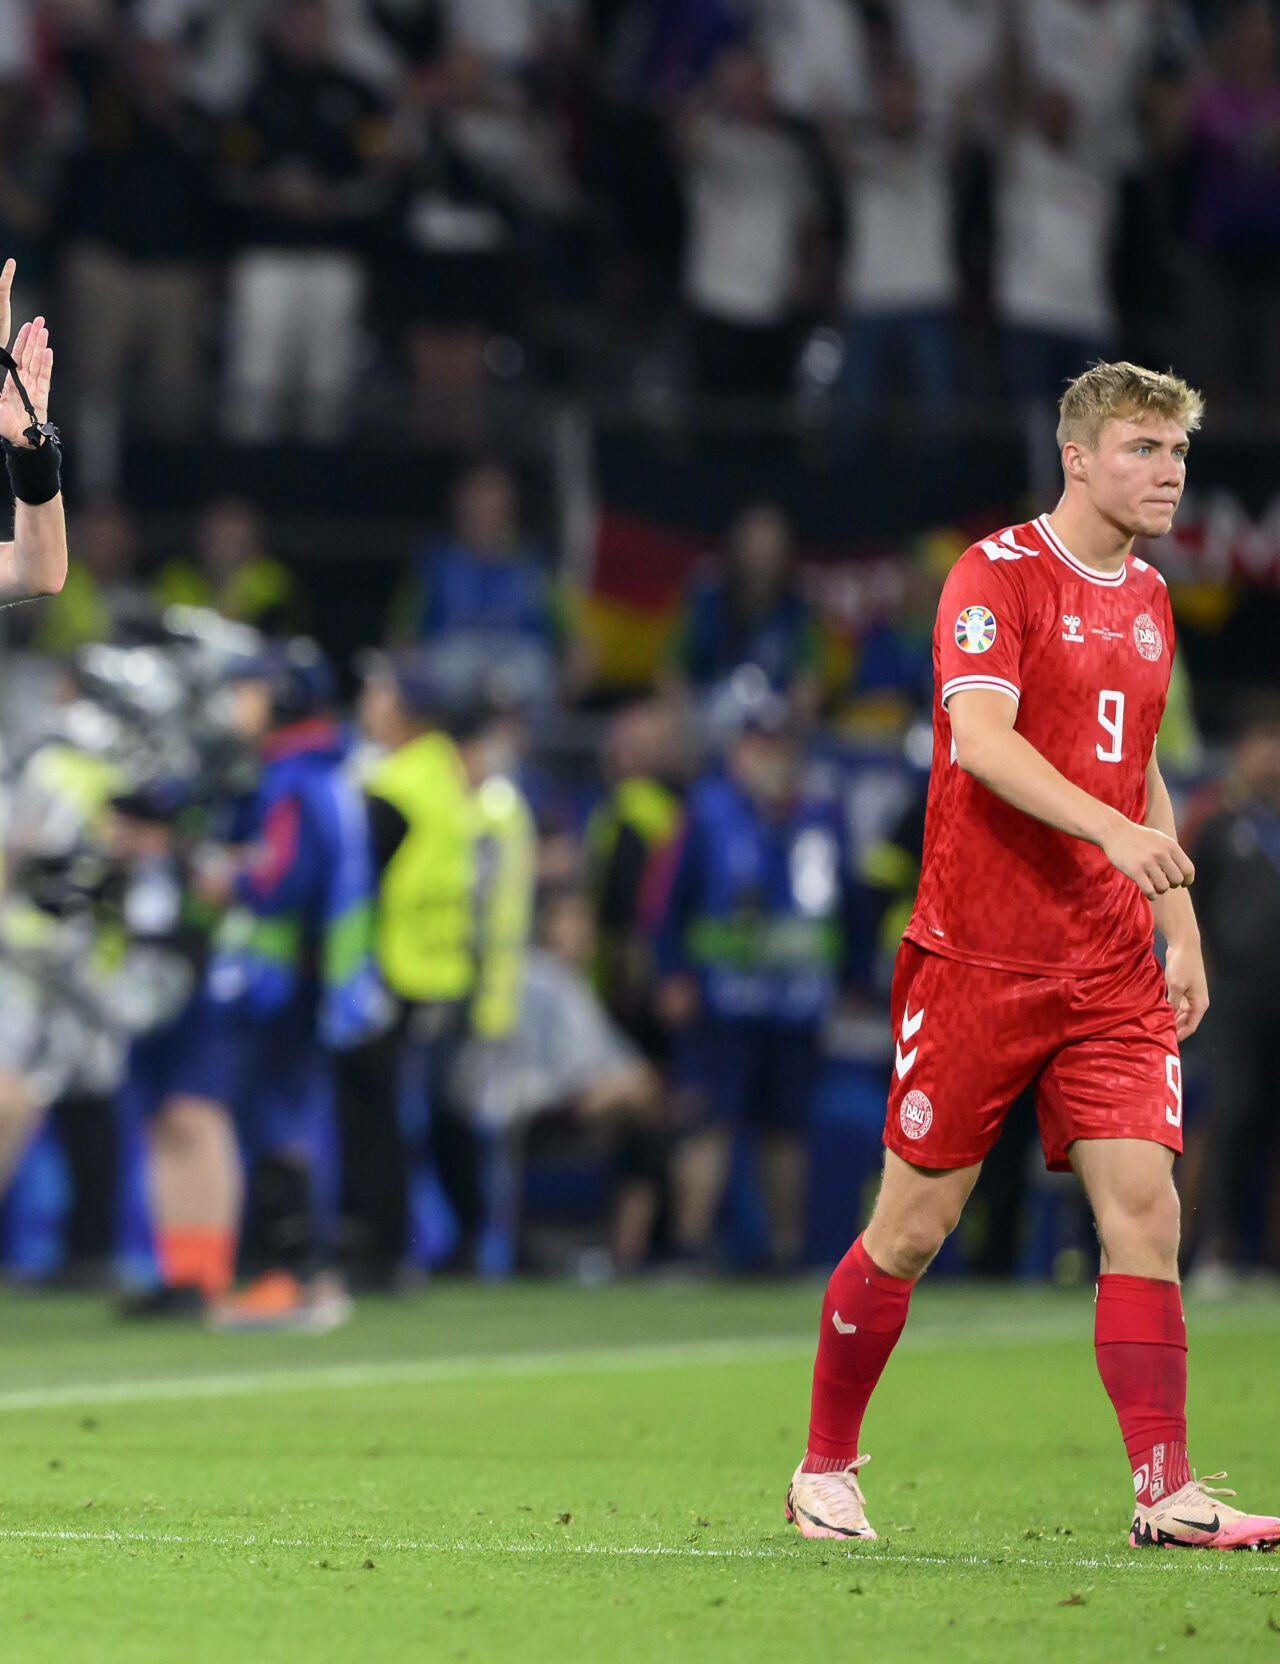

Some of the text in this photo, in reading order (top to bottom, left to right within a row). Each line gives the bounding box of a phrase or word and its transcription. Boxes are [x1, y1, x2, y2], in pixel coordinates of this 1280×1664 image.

[1096, 689, 1125, 763] 9
[906, 1103, 925, 1125] DBU
[1165, 1054, 1182, 1128] 9
